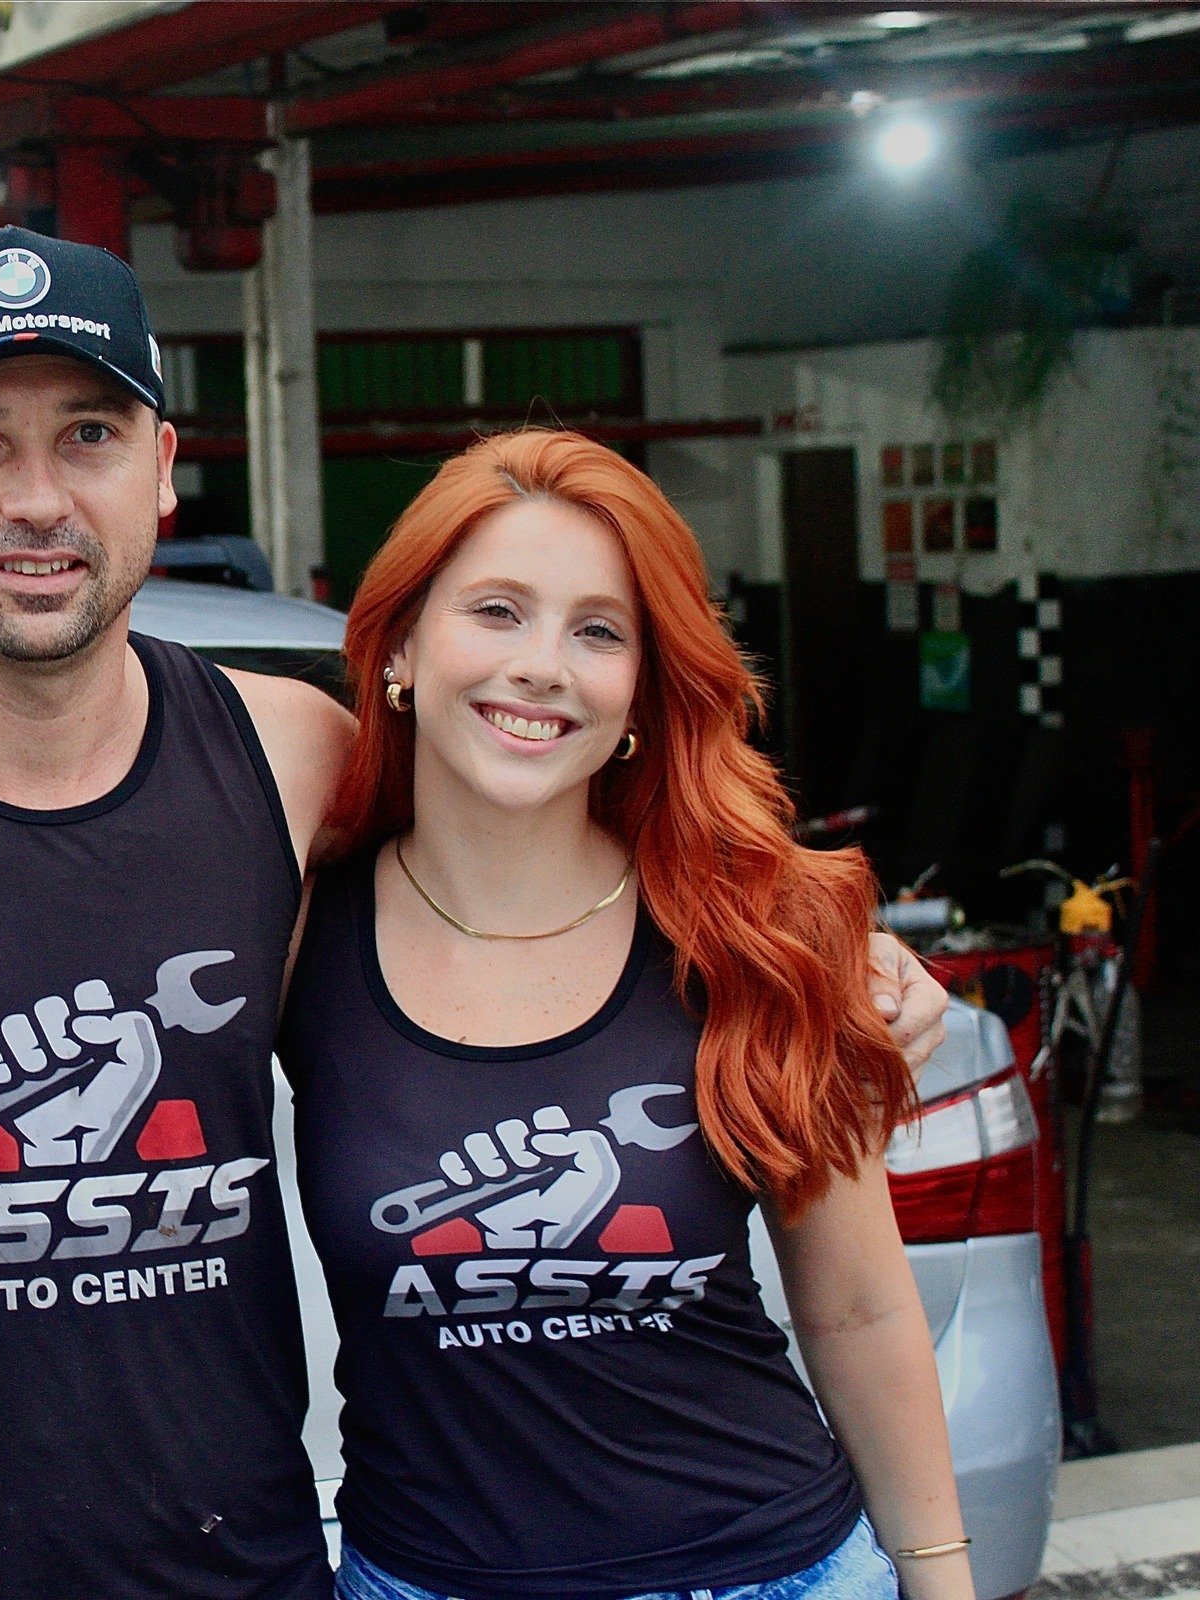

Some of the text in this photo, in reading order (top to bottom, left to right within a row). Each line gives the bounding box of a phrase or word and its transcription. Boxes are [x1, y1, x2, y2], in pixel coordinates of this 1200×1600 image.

[71, 1257, 229, 1304] CENTER
[383, 1252, 727, 1318] ASSIS
[438, 1320, 533, 1350] AUTO
